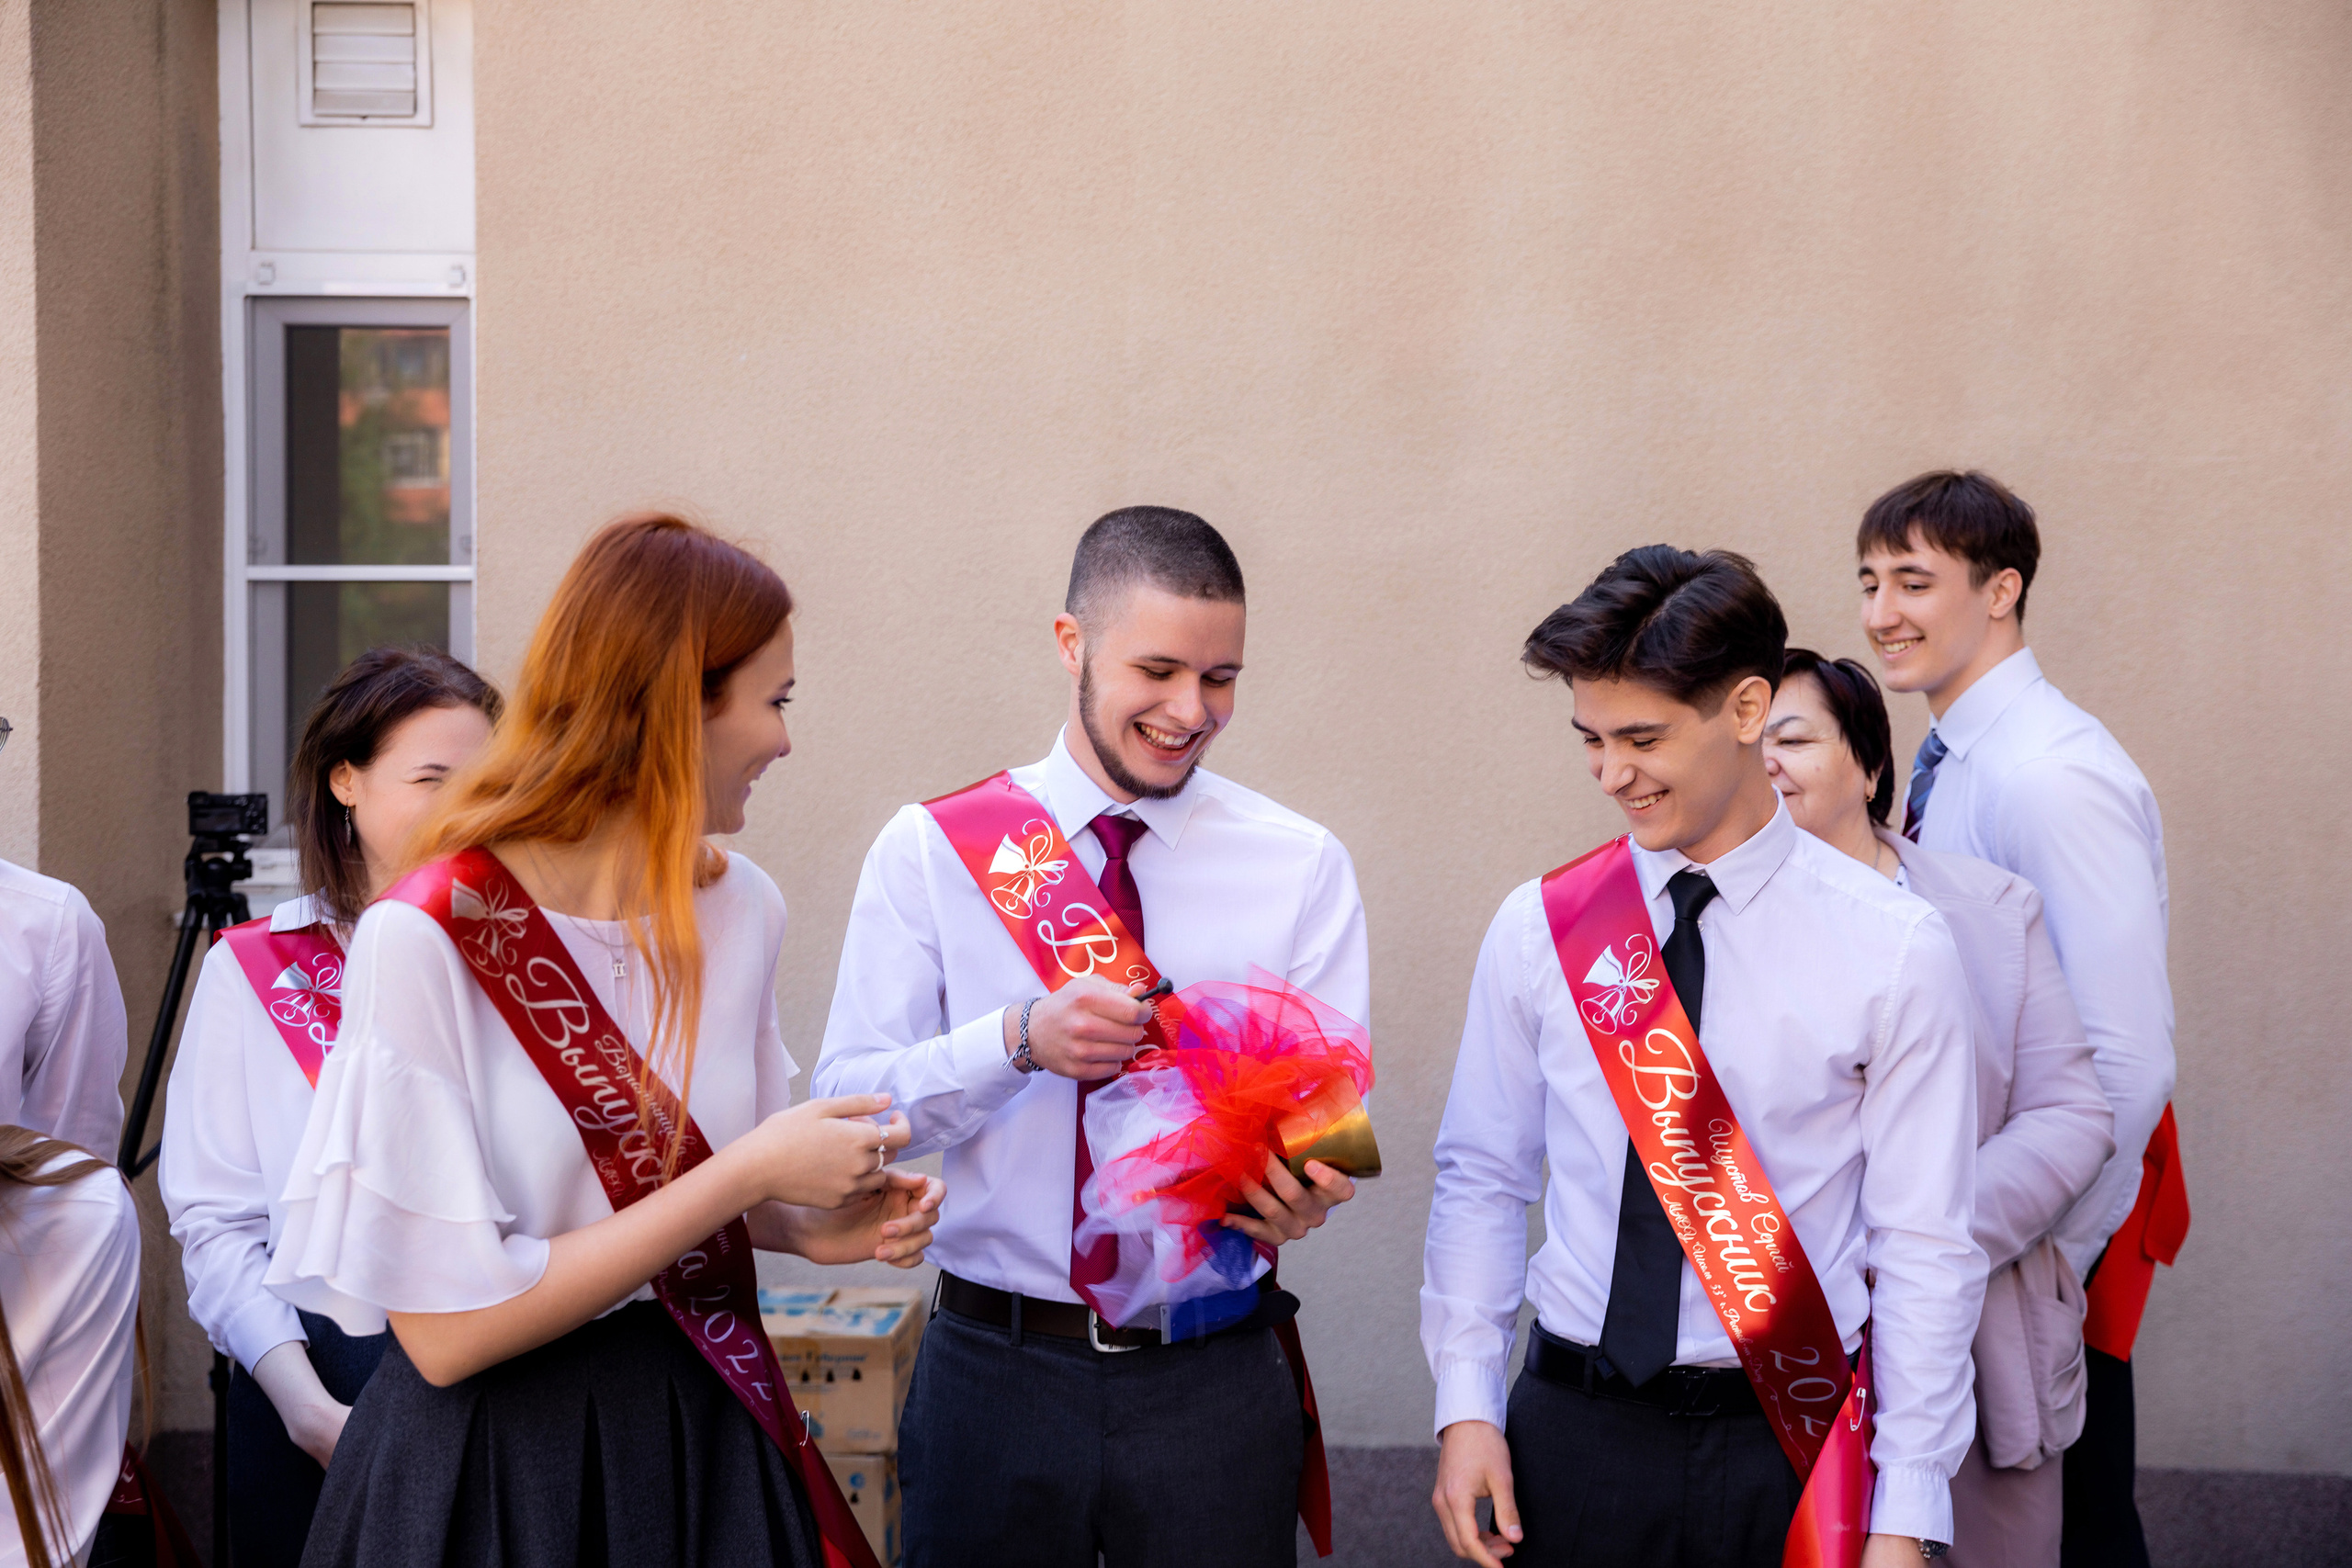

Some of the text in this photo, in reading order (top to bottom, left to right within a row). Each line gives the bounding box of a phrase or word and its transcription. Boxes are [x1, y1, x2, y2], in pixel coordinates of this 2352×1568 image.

[1618, 1028, 1777, 1312] Выпускник
[1708, 1118, 1794, 1273] Шустов Сергей
